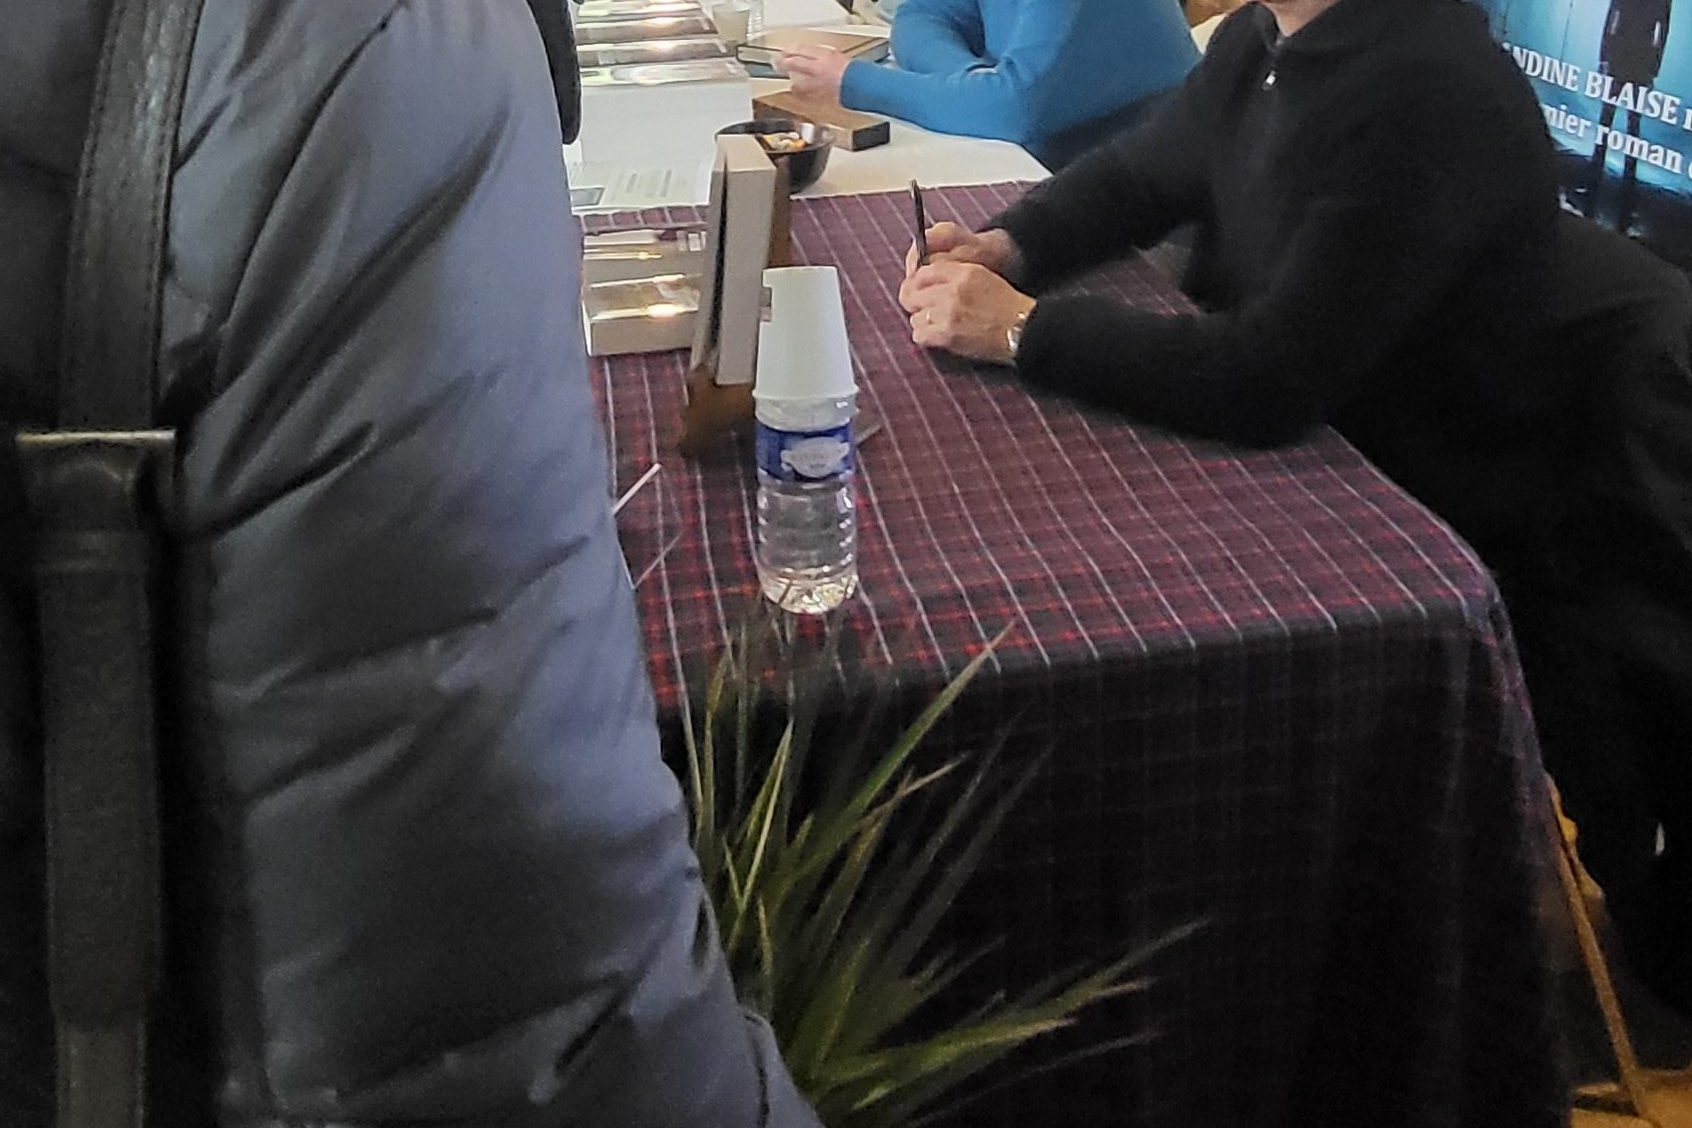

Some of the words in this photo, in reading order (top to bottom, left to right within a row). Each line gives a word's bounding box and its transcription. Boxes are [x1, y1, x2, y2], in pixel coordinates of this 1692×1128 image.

[1502, 41, 1581, 92] NDINE
[1584, 71, 1681, 126] BLAISE
[1595, 124, 1684, 174] roman
